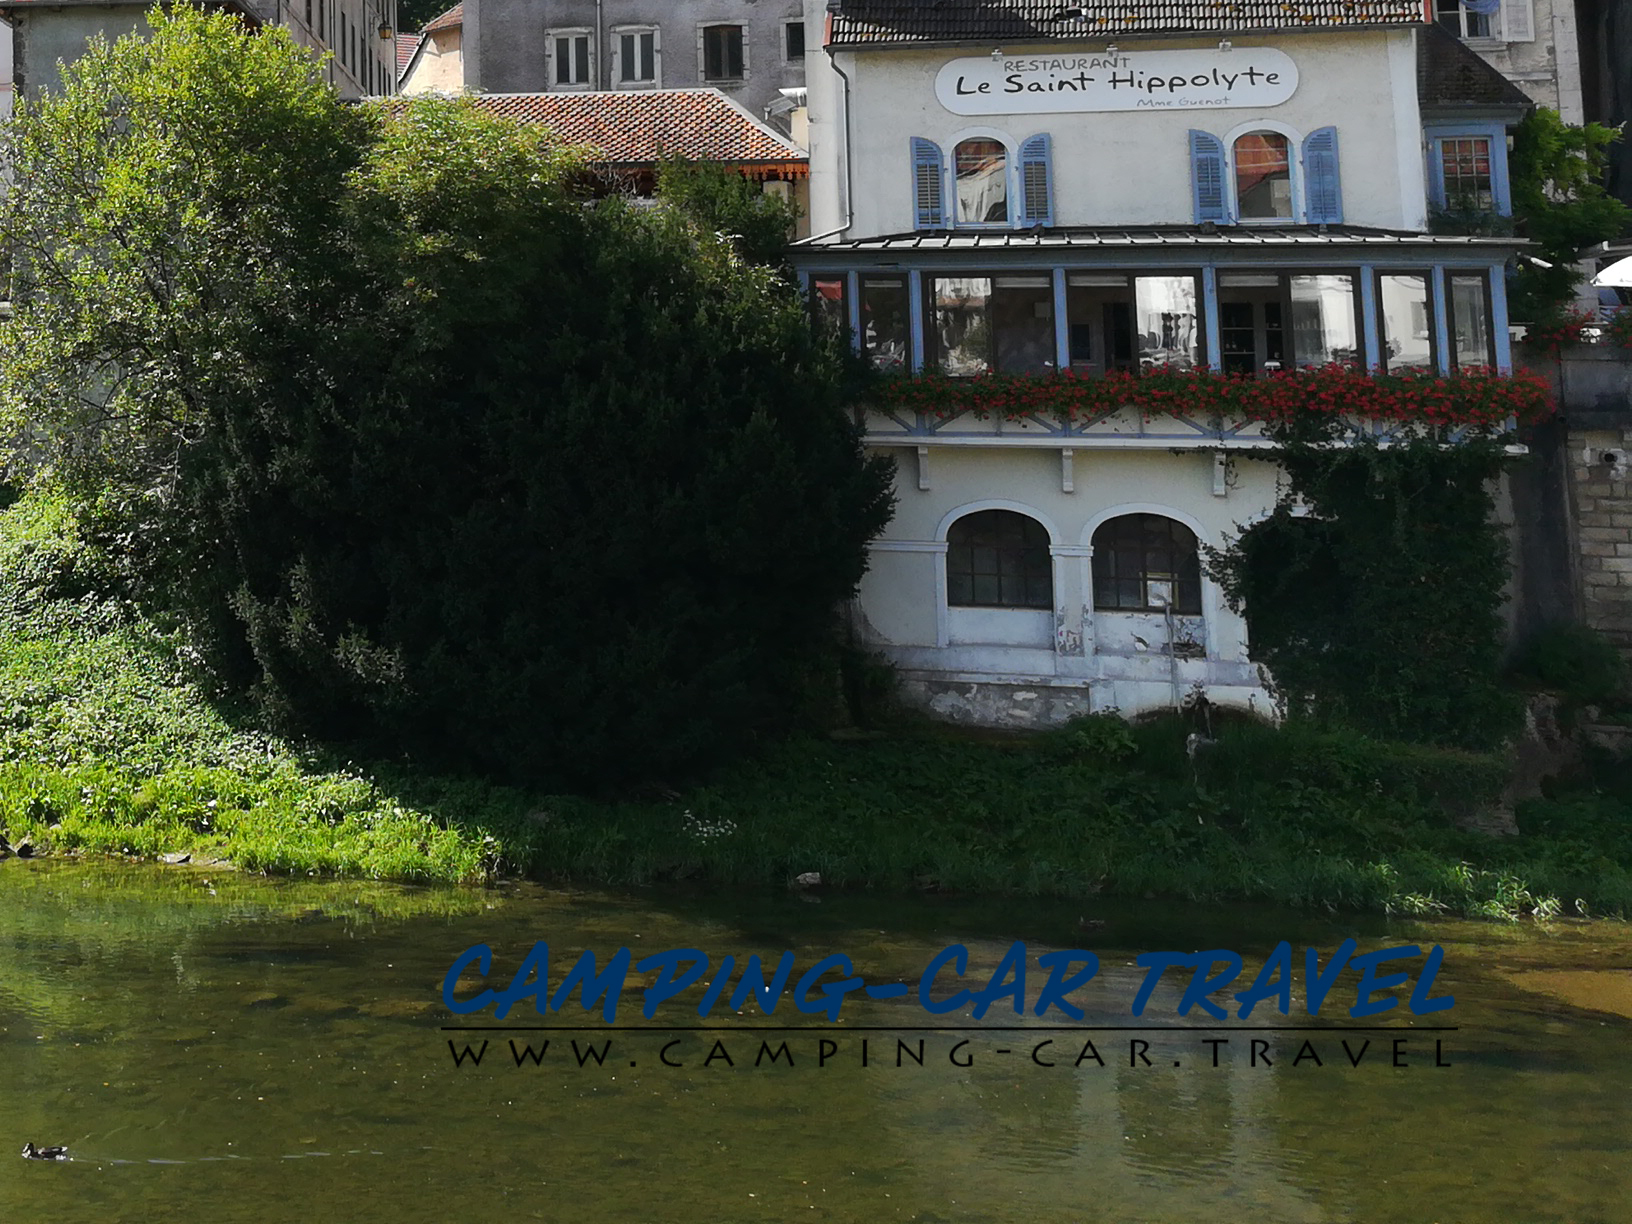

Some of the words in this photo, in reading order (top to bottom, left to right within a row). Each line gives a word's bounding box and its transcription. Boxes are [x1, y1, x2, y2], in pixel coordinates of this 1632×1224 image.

[1003, 57, 1132, 73] RESTAURANT
[956, 75, 992, 96] Le
[1003, 70, 1096, 94] Saint
[1107, 65, 1281, 94] Hippolyte
[1136, 98, 1173, 108] Mme
[1178, 95, 1232, 107] Guenot
